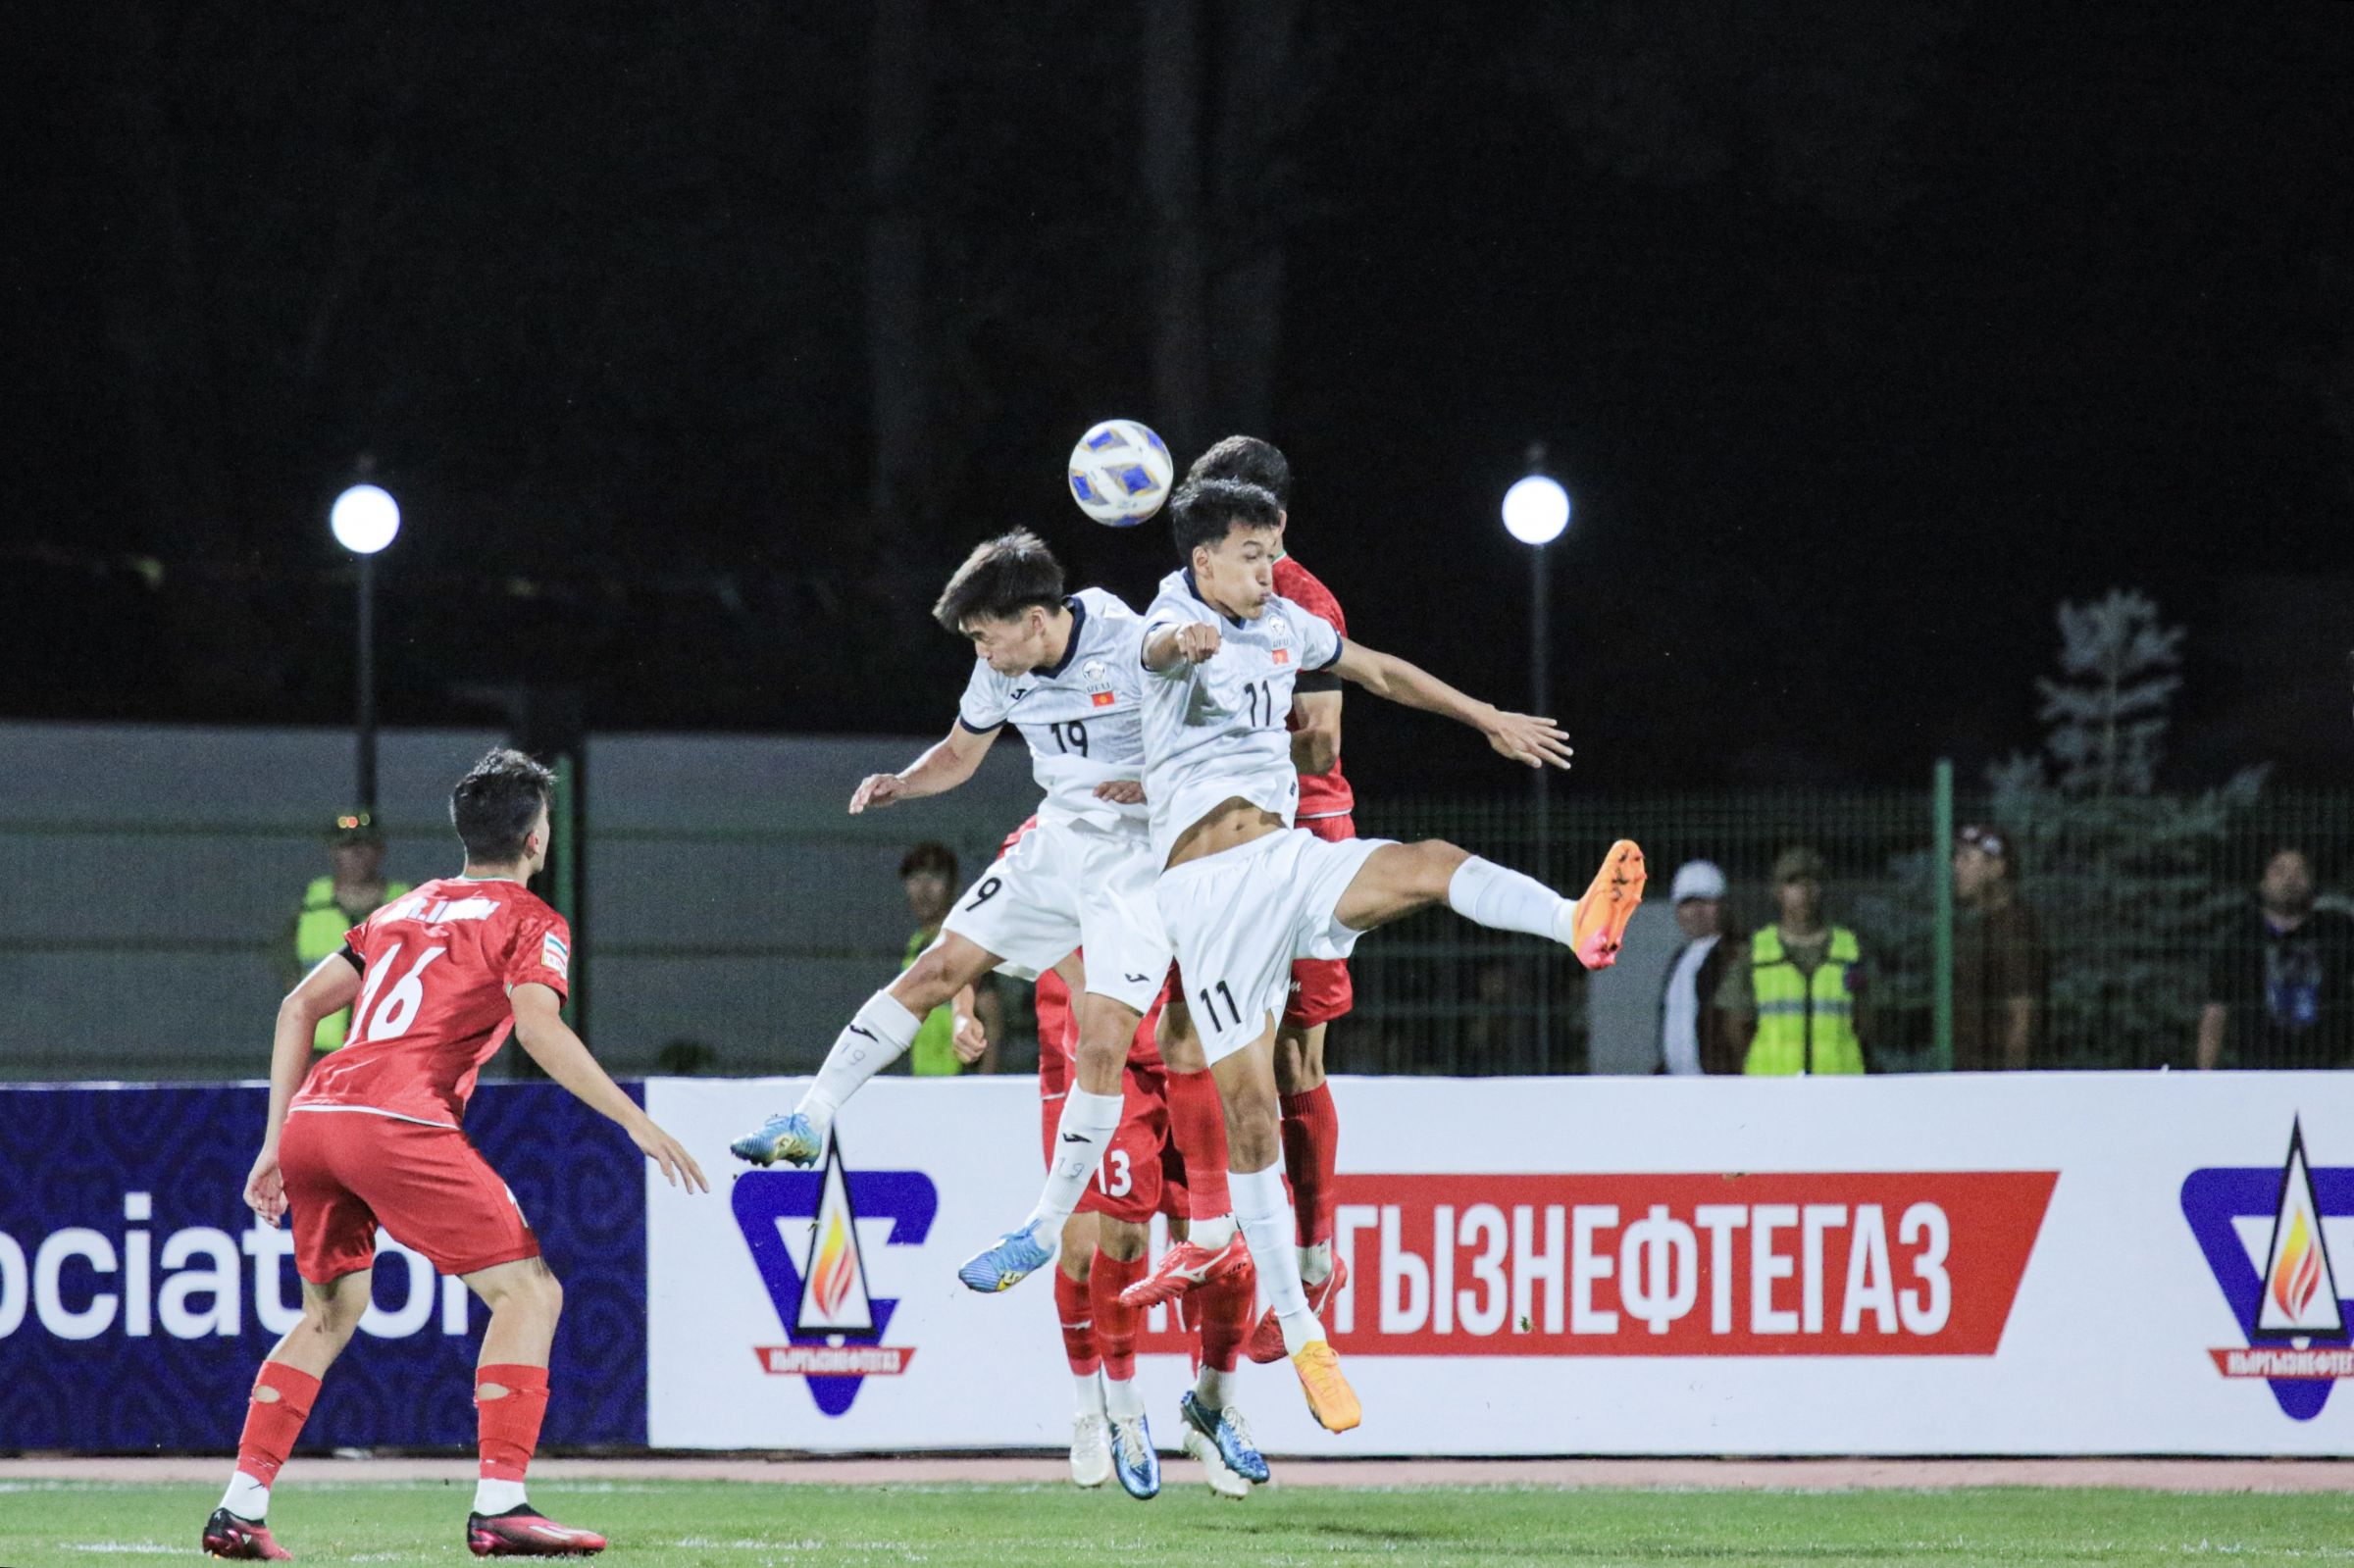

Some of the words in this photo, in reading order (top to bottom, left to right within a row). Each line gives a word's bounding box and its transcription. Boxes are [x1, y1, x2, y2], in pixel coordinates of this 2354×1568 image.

[1244, 680, 1271, 728] 11
[1050, 720, 1088, 758] 19
[965, 877, 1002, 912] 9
[343, 942, 446, 1047] 16
[1200, 980, 1242, 1033] 11
[0, 1192, 468, 1340] ciatio
[1148, 1202, 1952, 1336] ГЫЗНЕФТЕГАЗ
